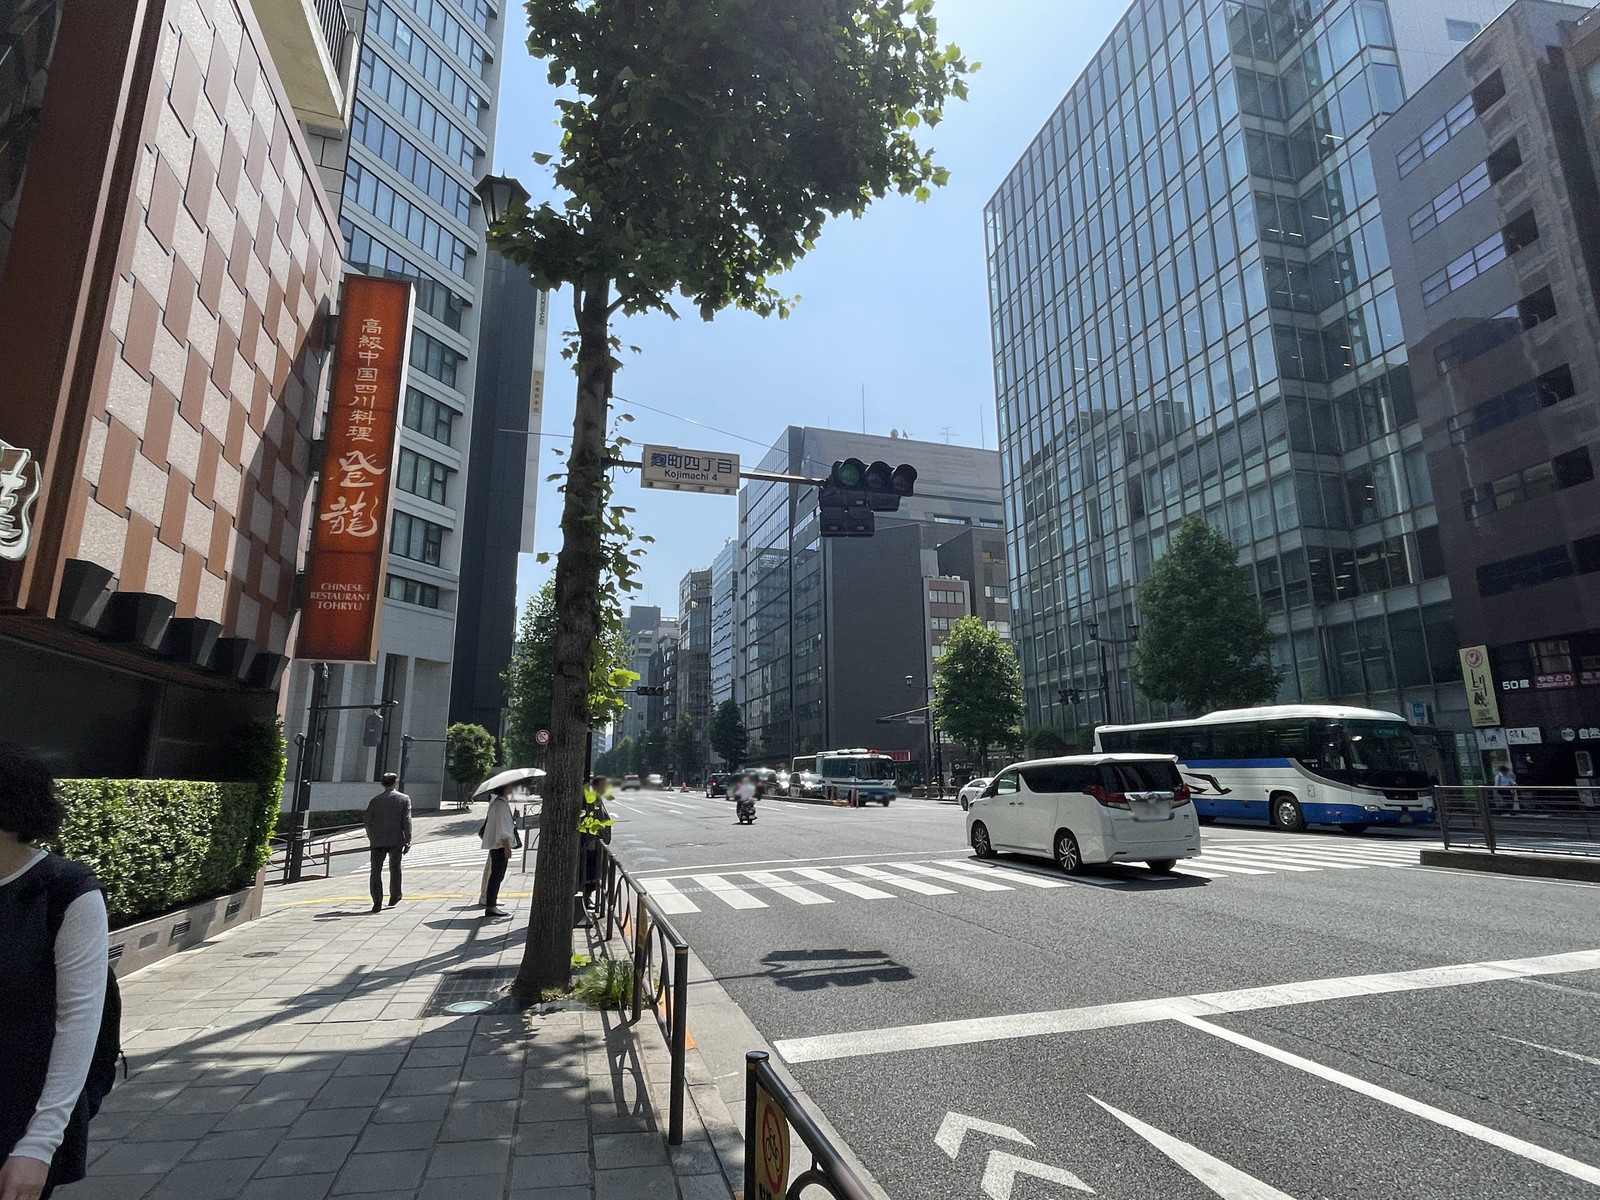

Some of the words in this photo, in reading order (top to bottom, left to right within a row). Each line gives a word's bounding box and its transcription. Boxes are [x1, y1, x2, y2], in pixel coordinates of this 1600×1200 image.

[346, 317, 385, 443] 高級中国四川料理
[664, 469, 709, 481] Kojimachi
[712, 473, 718, 481] 4
[321, 582, 363, 592] CHINESE
[310, 591, 371, 601] RESTAURANT
[317, 600, 362, 611] TOHRYU
